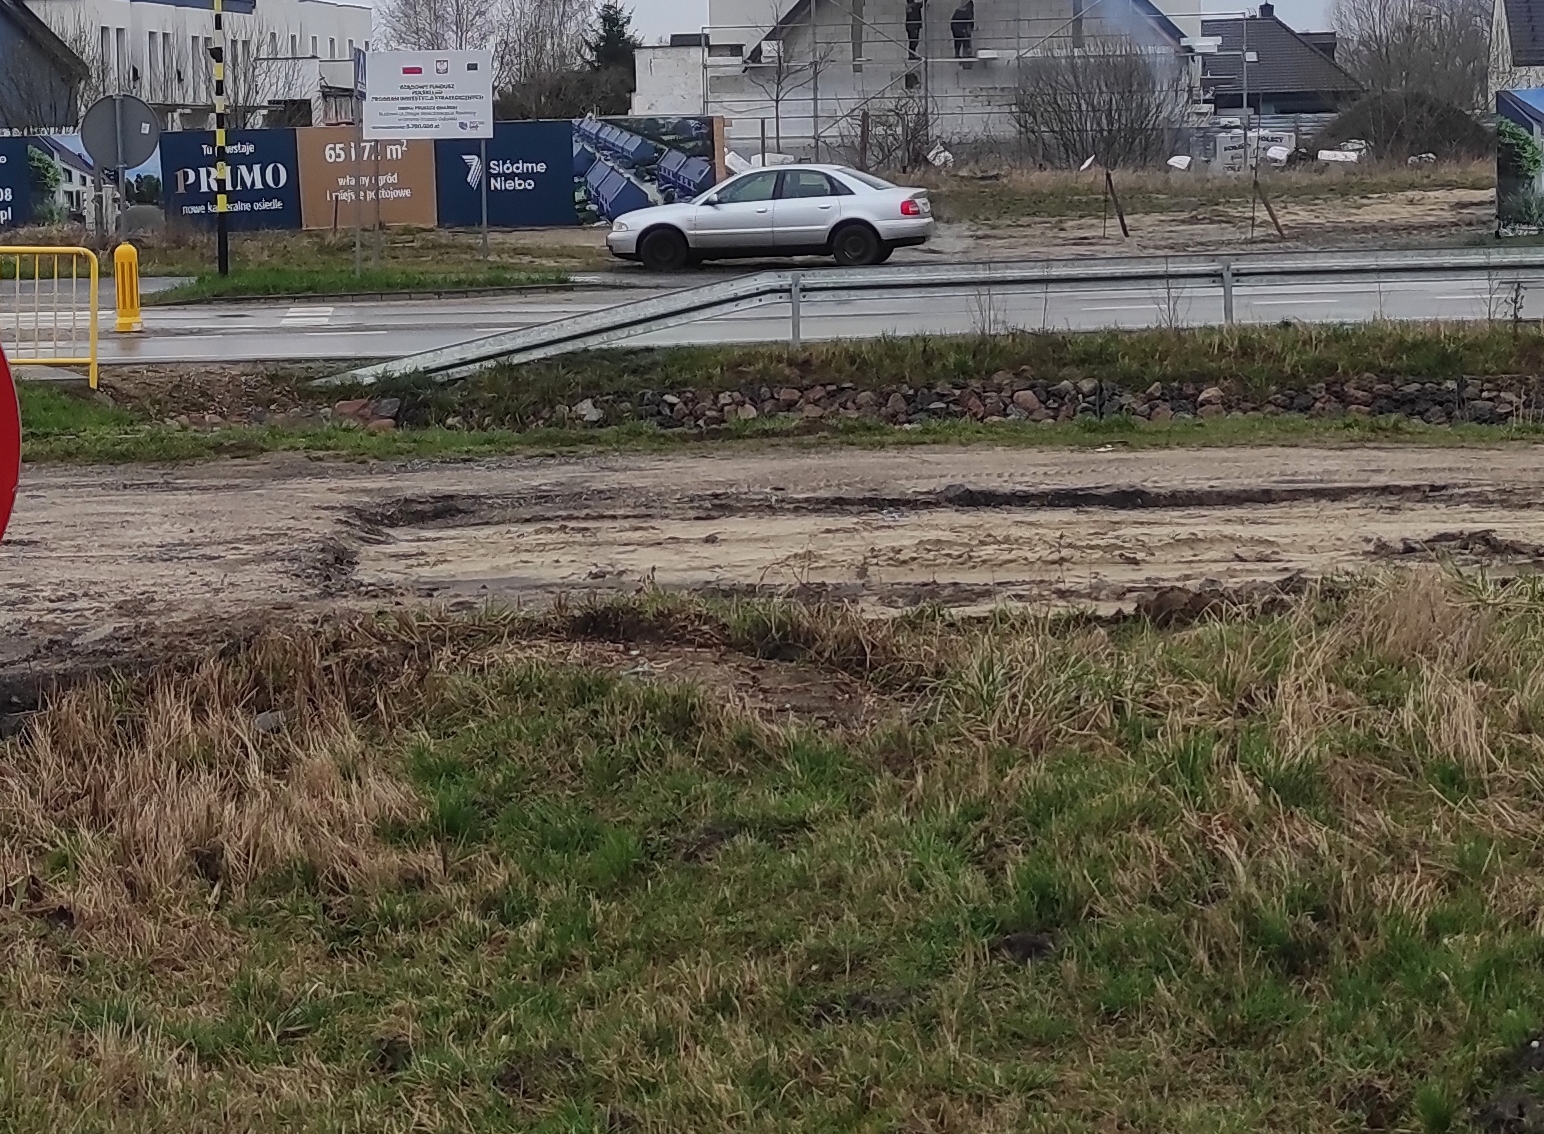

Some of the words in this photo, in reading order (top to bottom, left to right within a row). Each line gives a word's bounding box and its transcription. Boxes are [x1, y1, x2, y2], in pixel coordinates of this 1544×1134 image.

[201, 144, 213, 156] Tu
[214, 141, 255, 157] wstaje
[325, 143, 346, 162] 65
[489, 160, 547, 174] Siódme
[174, 162, 287, 194] PRIMO
[338, 175, 370, 187] włany
[371, 172, 398, 187] gród
[490, 177, 535, 190] Niebo
[332, 190, 364, 203] miejse
[367, 188, 412, 202] potojowe
[207, 202, 252, 213] kaeralne
